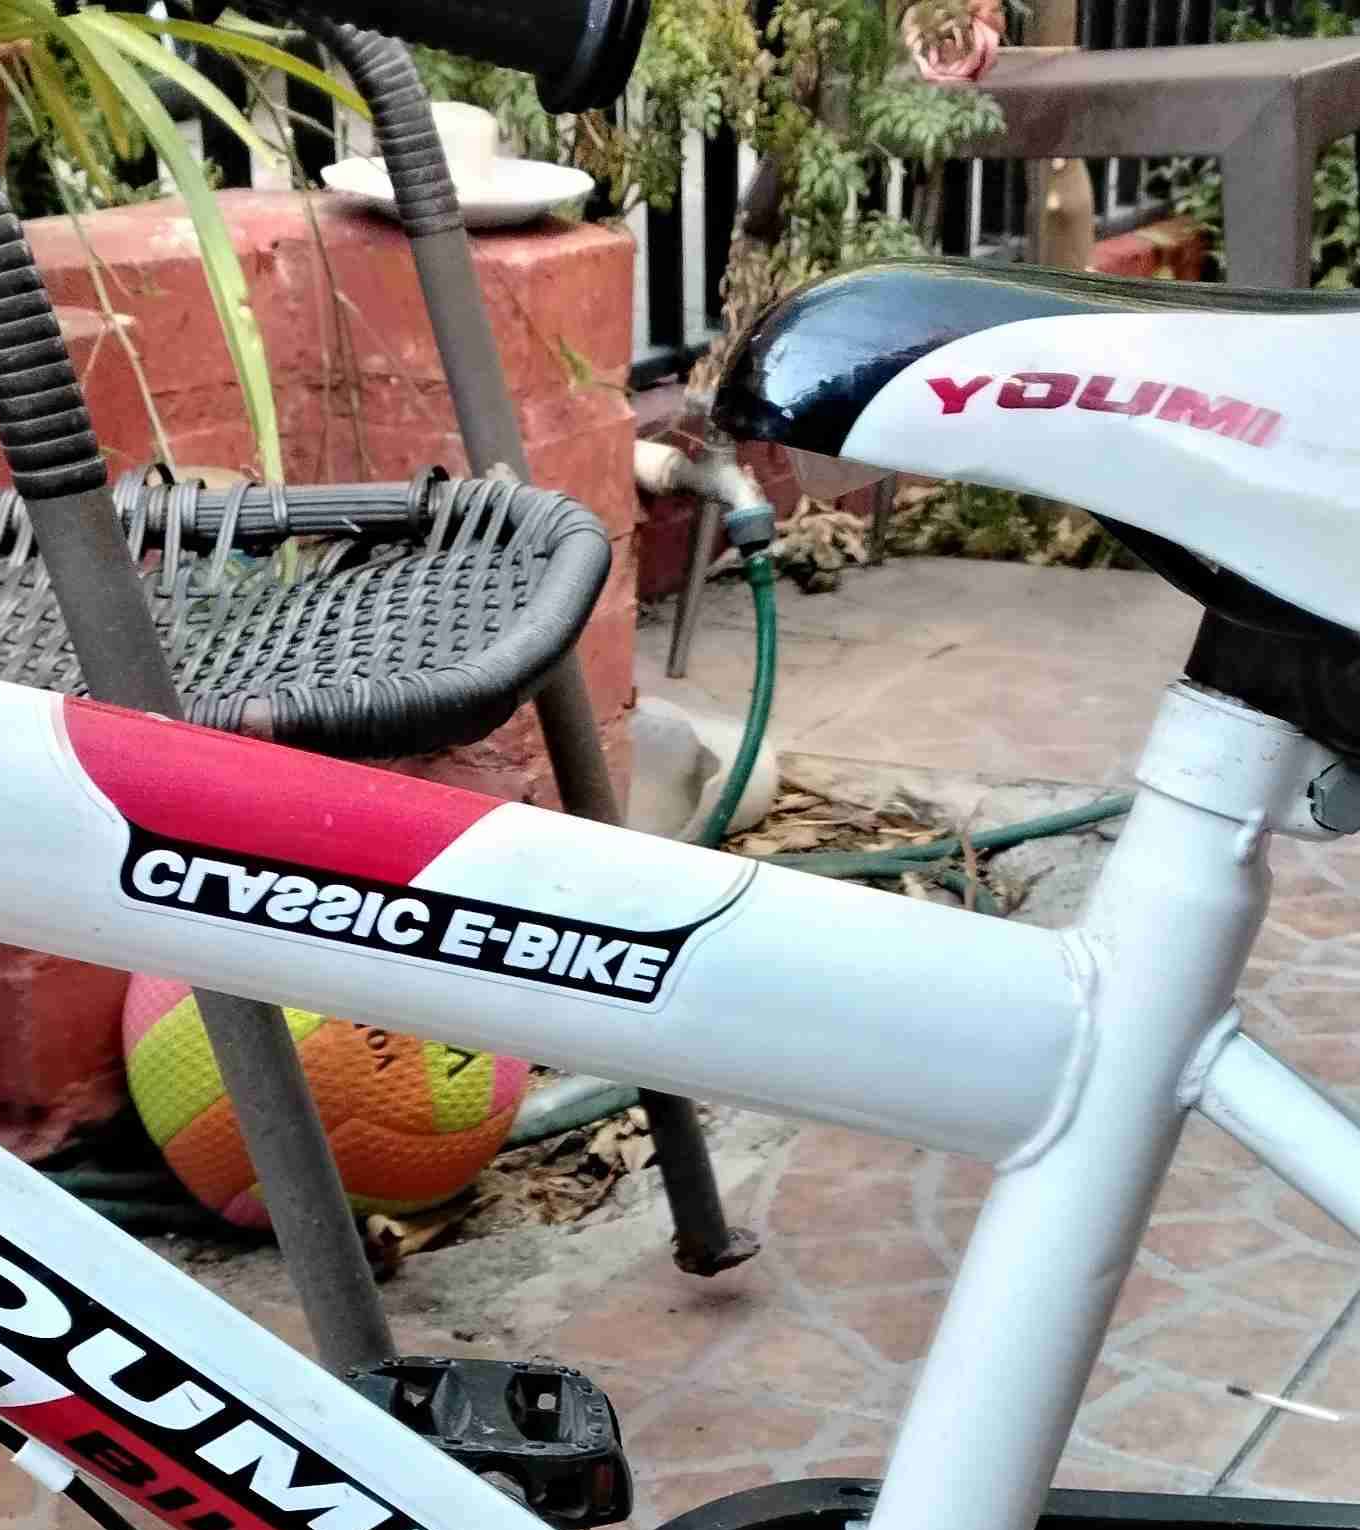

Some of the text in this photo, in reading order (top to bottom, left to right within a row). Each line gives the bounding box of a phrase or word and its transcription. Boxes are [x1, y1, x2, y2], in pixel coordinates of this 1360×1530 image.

[927, 372, 1282, 447] YOUMI
[132, 849, 671, 994] CLASSIC E-BIKE
